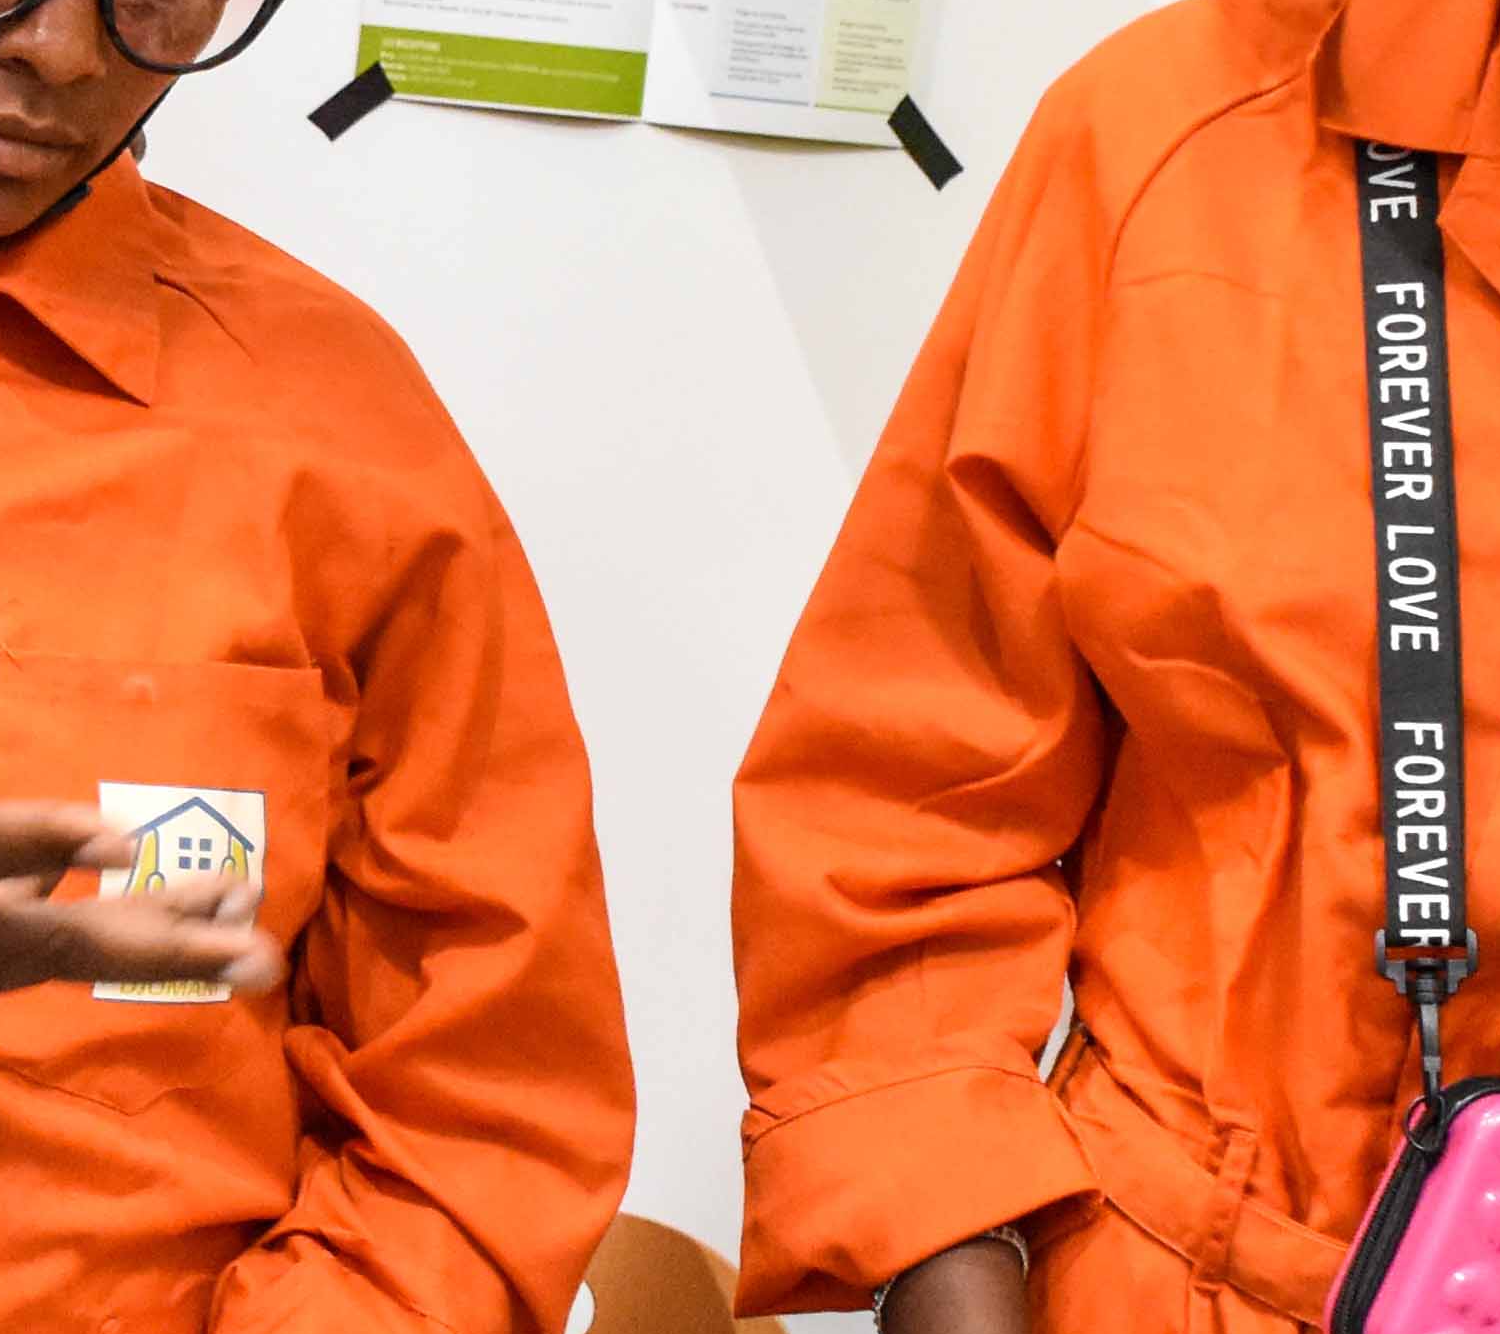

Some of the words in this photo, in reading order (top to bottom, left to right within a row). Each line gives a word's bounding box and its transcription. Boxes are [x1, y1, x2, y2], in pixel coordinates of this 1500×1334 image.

[1366, 143, 1419, 225] OVE
[1374, 279, 1435, 502] FOREVER
[1384, 523, 1441, 655] LOVE
